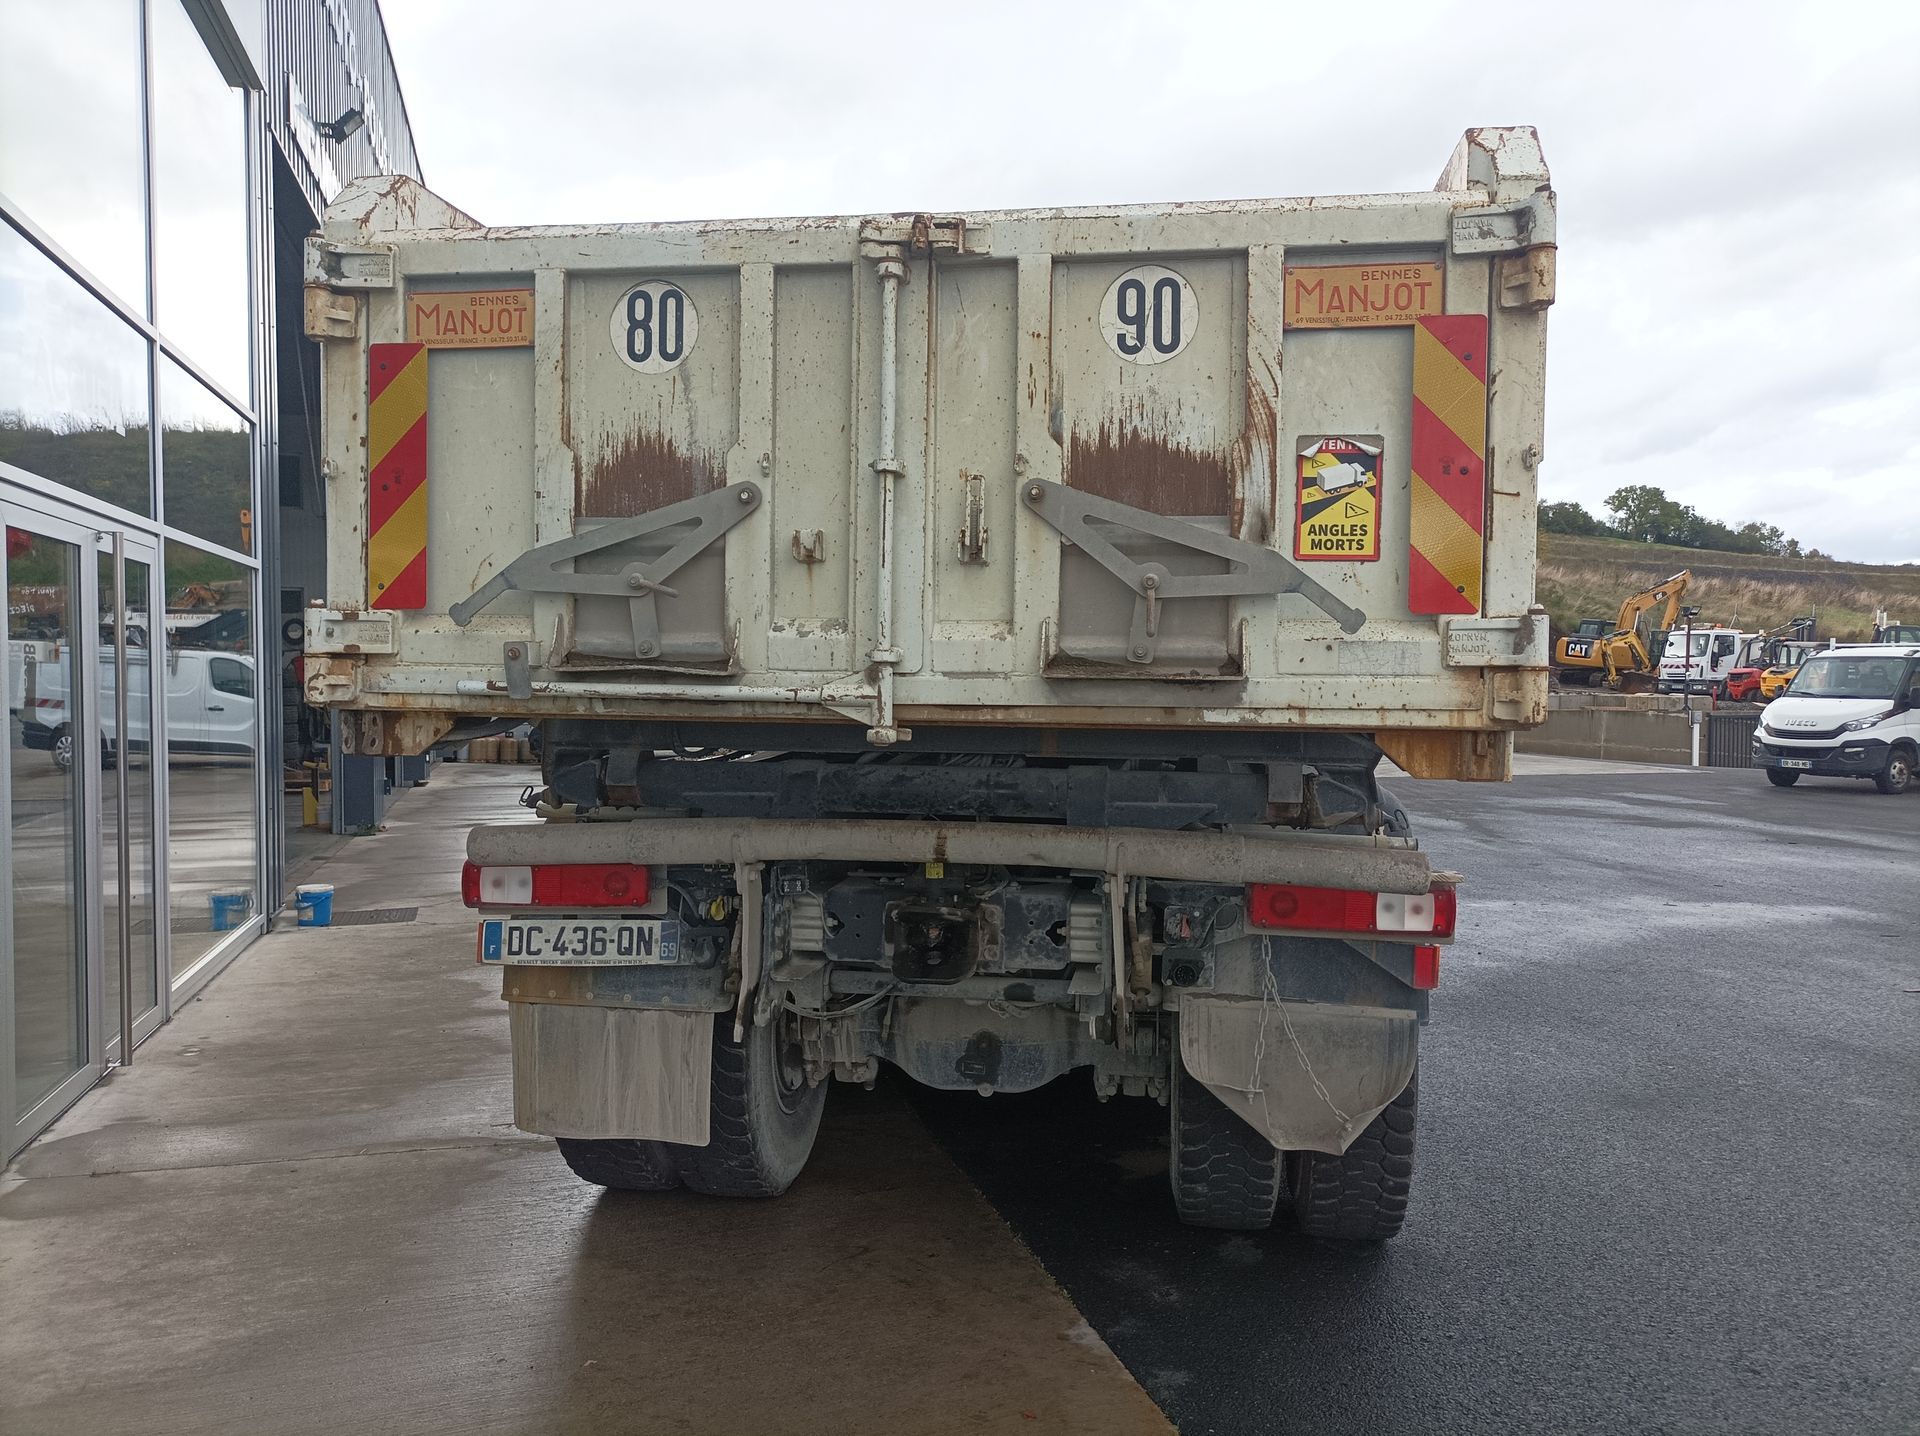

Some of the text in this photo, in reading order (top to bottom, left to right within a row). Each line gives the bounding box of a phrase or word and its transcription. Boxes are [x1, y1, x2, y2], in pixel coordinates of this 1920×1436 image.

[1361, 269, 1421, 281] BENNES
[470, 295, 519, 306] BENNES
[1295, 278, 1433, 314] MANJOT
[415, 303, 527, 336] MANJOT
[1117, 277, 1181, 355] 90
[627, 289, 684, 363] 80
[1307, 524, 1368, 537] ANGLES
[1310, 538, 1365, 551] MORTS
[1568, 643, 1588, 656] CAT
[1784, 719, 1817, 727] IVECO
[507, 926, 654, 956] DC-436-QN
[489, 945, 496, 954] F
[660, 943, 676, 957] 69
